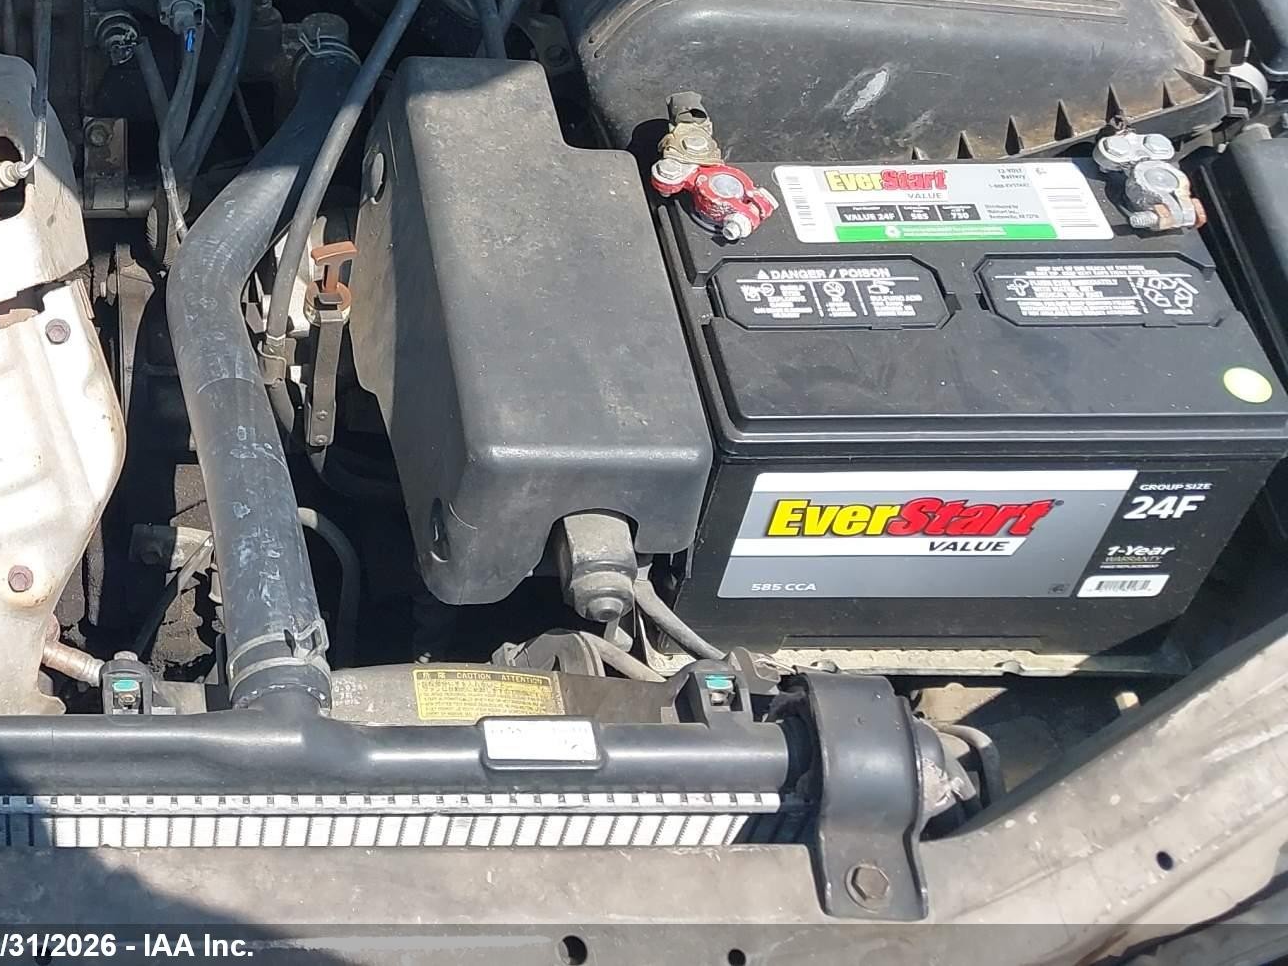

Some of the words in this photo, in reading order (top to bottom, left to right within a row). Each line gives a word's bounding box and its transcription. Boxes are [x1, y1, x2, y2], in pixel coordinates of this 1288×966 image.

[823, 169, 947, 192] EverStart
[844, 212, 877, 222] VALUE
[770, 270, 827, 279] DANGER
[839, 267, 891, 279] POISON
[1139, 483, 1184, 491] GROUP
[1184, 482, 1213, 490] SIZE
[1123, 494, 1207, 520] 24F
[765, 497, 1057, 537] EverStart
[928, 540, 1011, 553] VALUE
[1107, 545, 1177, 556] 1-Year
[751, 583, 783, 592] 585
[784, 583, 817, 592] CCA
[456, 672, 491, 680] CAUTION
[501, 674, 543, 685] ATTENTION
